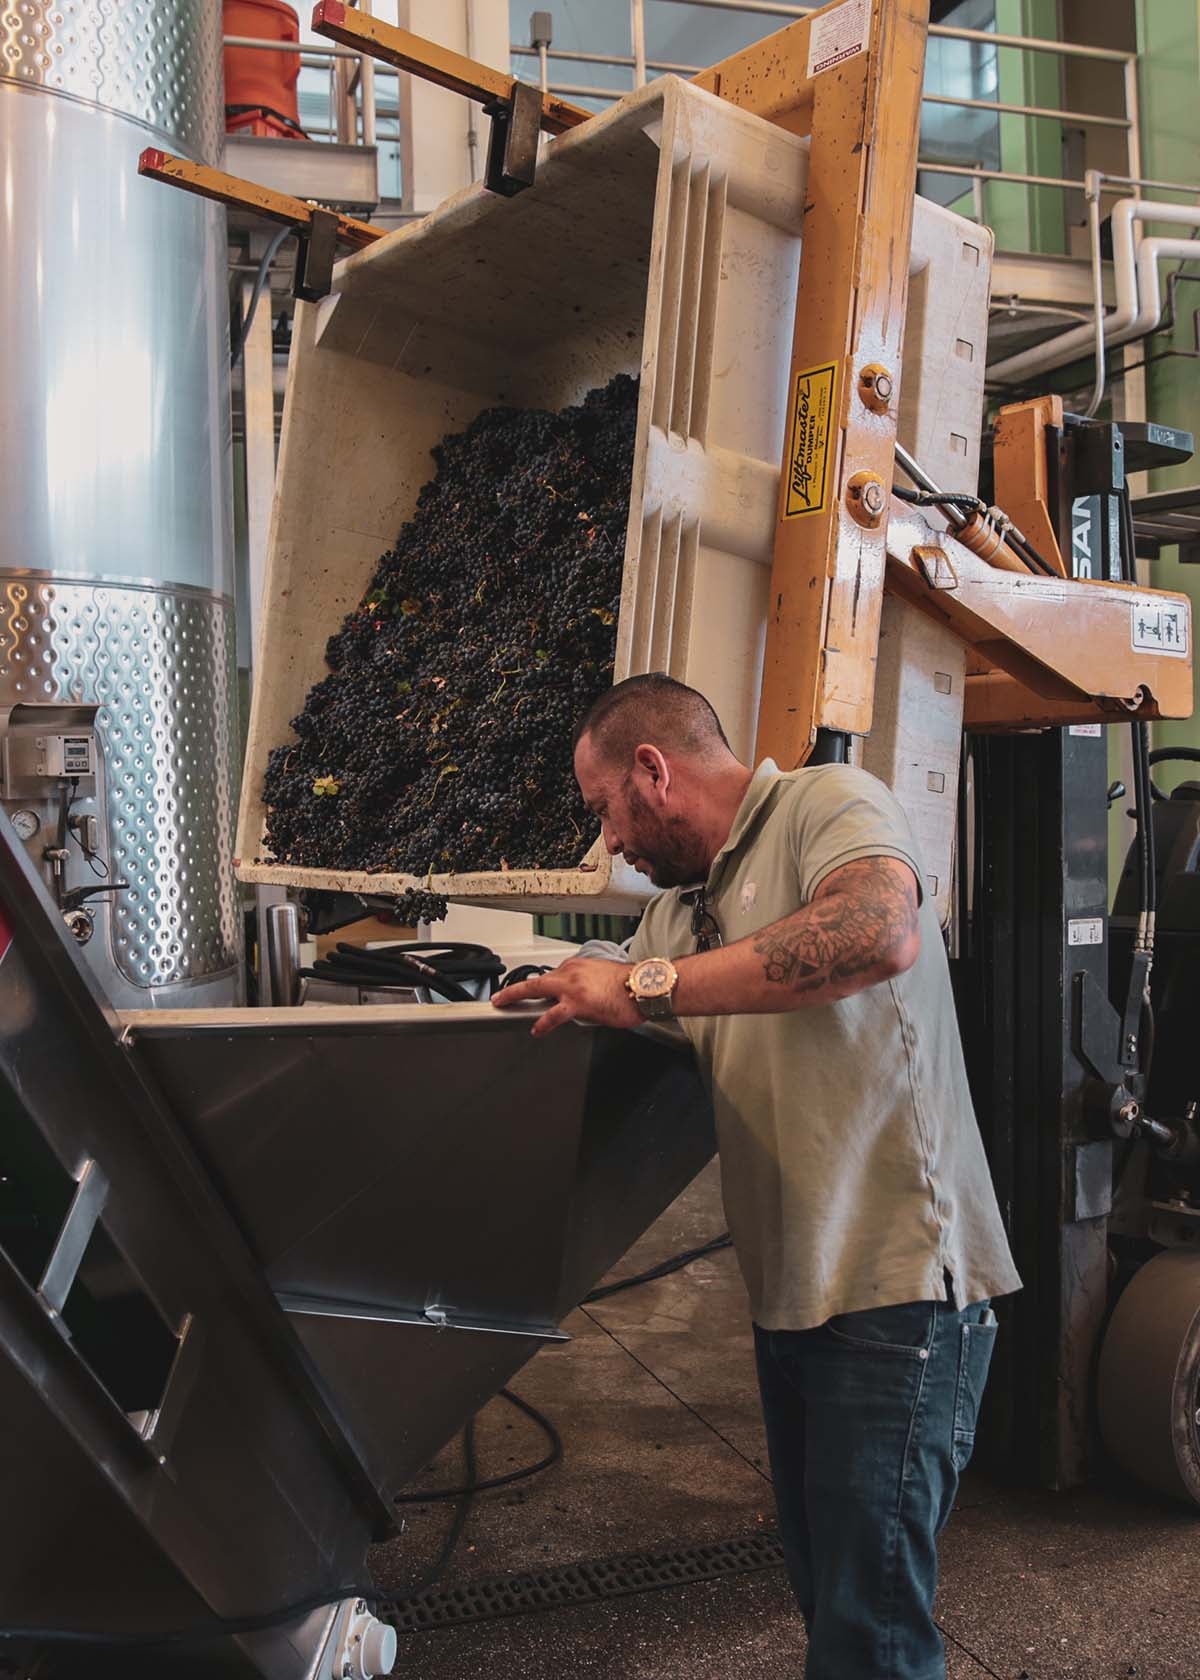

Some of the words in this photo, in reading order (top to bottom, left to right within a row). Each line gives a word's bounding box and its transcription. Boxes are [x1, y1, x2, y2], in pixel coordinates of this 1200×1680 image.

[815, 46, 860, 71] WARNING
[792, 379, 812, 507] Liftmaster
[807, 415, 816, 464] DUMPER
